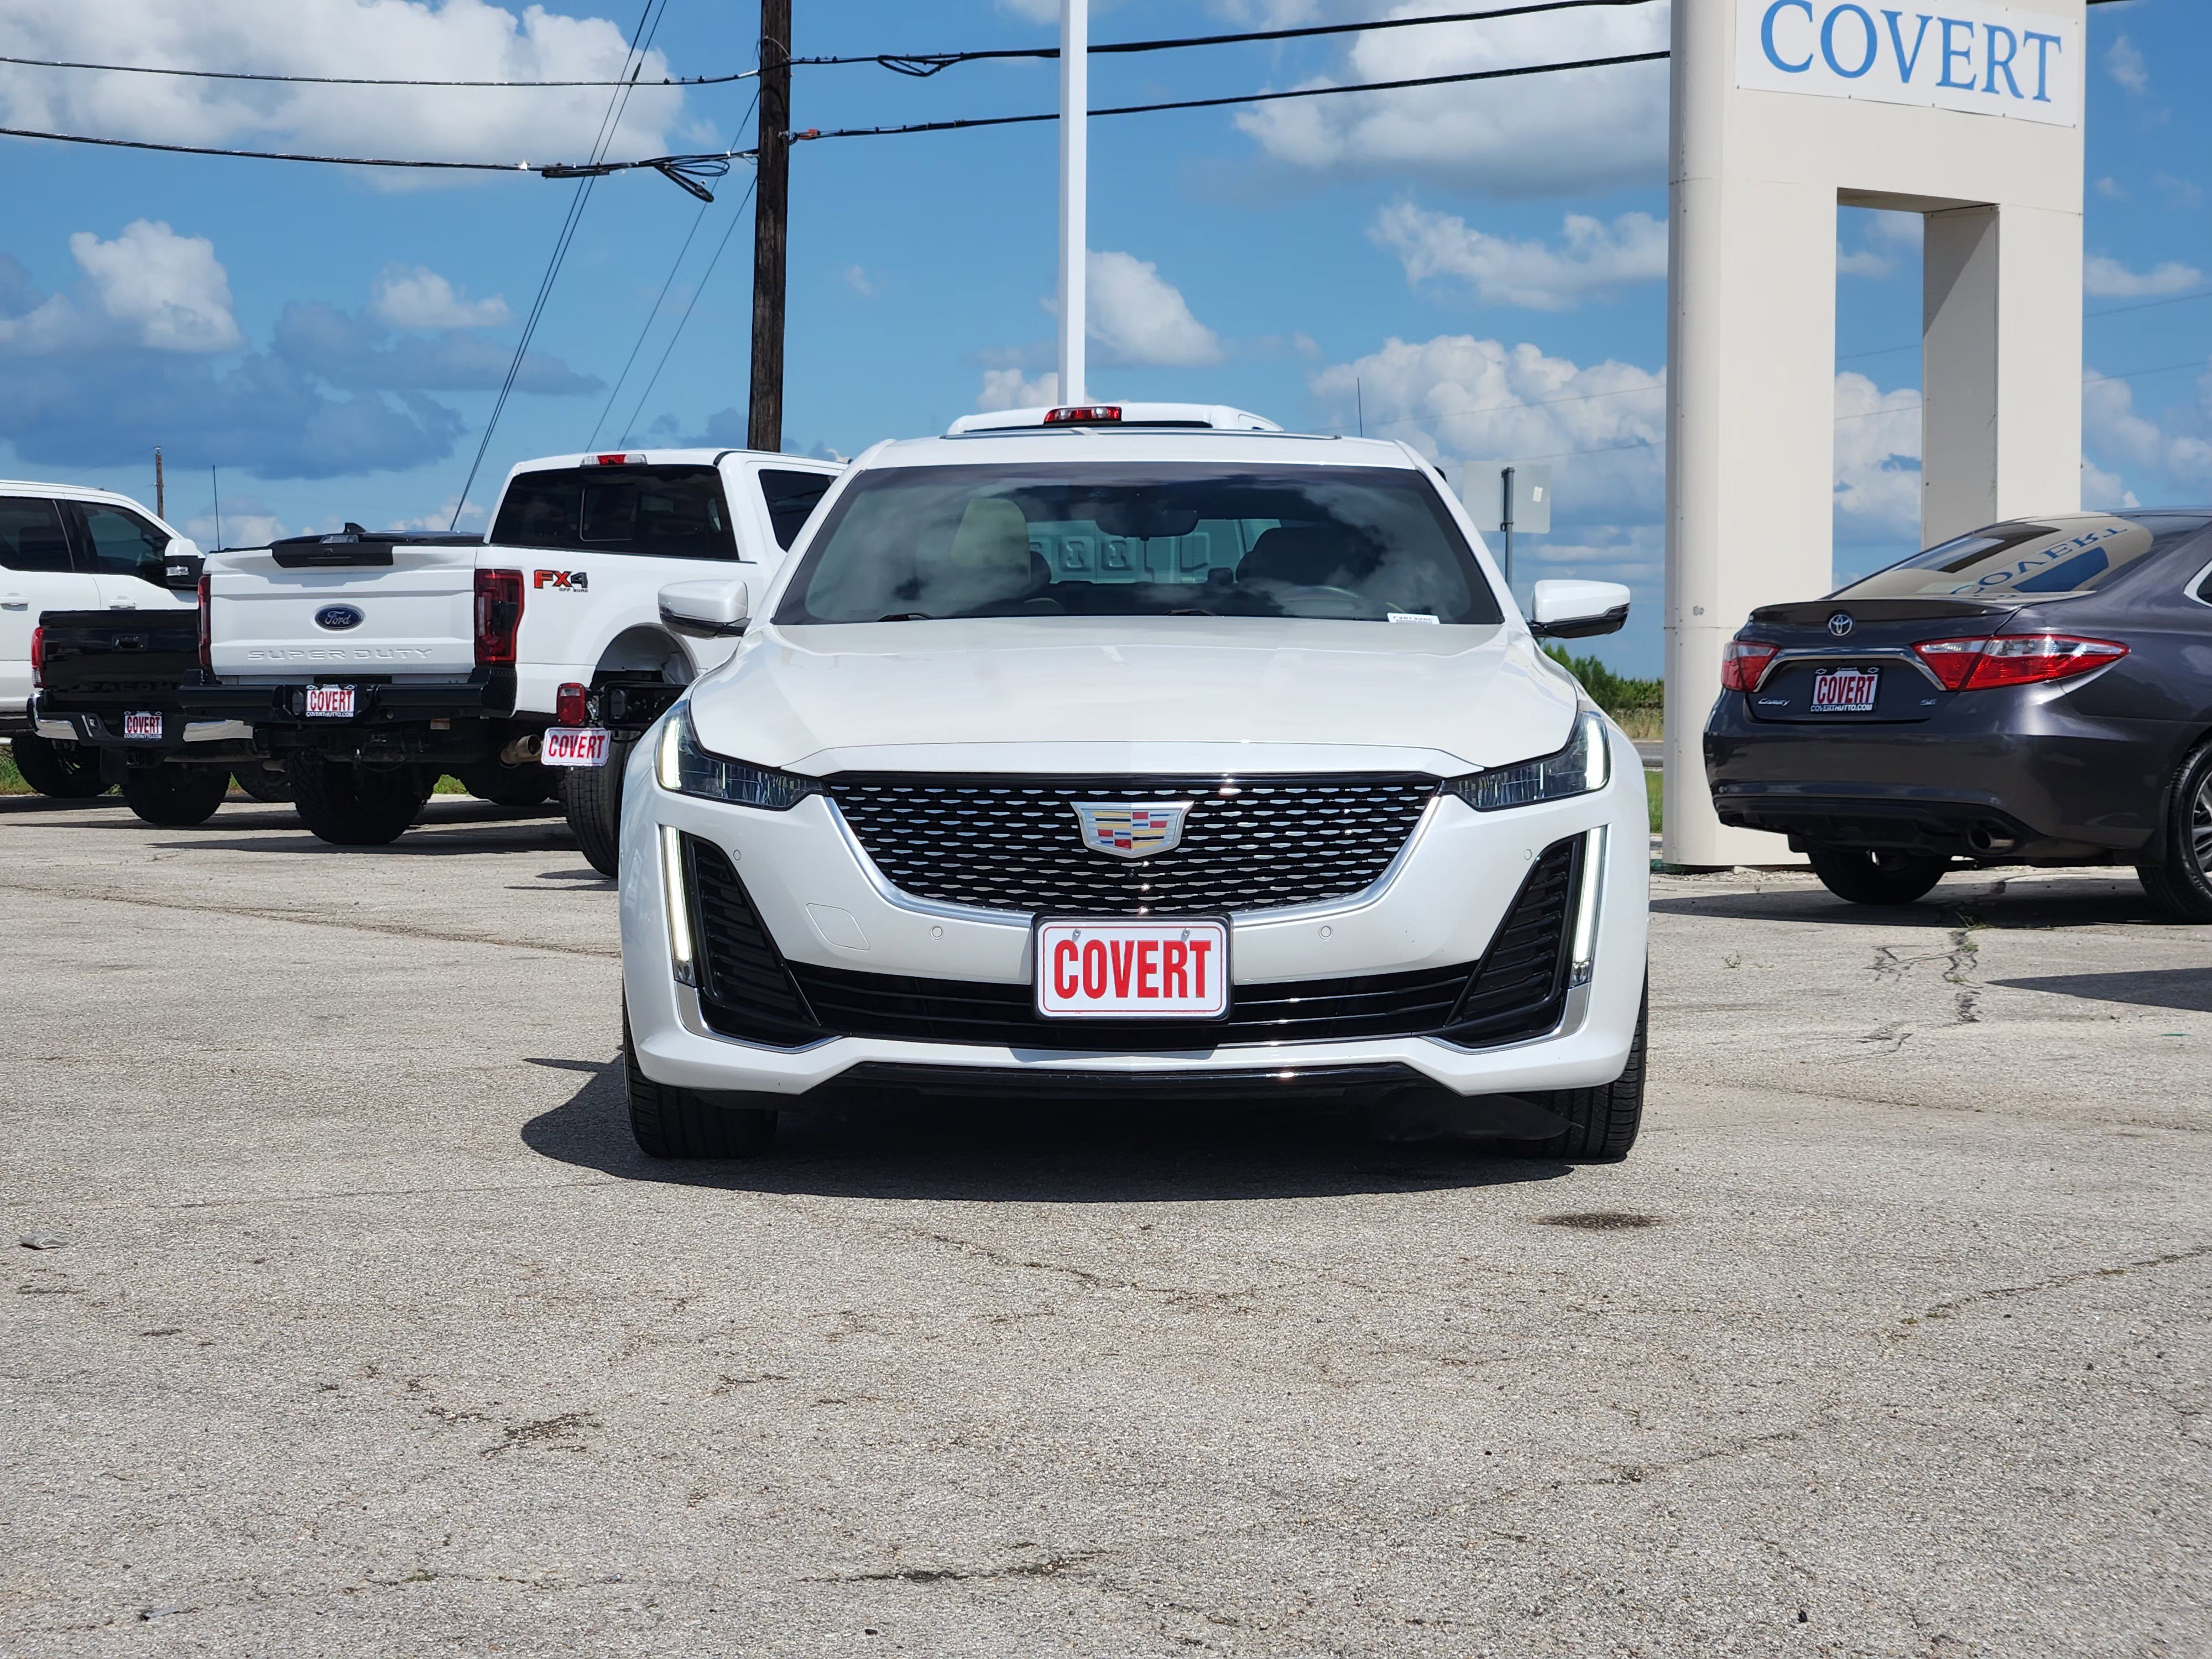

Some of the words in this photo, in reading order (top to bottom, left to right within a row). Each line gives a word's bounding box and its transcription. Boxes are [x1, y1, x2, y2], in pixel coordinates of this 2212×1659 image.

[1761, 0, 2062, 103] COVERT
[534, 570, 588, 589] FX4
[325, 611, 352, 625] Ford
[248, 650, 346, 660] SUPER
[353, 649, 432, 659] DUTY
[310, 690, 352, 712] COVERT
[1817, 676, 1876, 704] COVERT
[127, 716, 160, 734] COVERT
[549, 734, 606, 758] COVERT
[1053, 938, 1212, 999] COVERT
